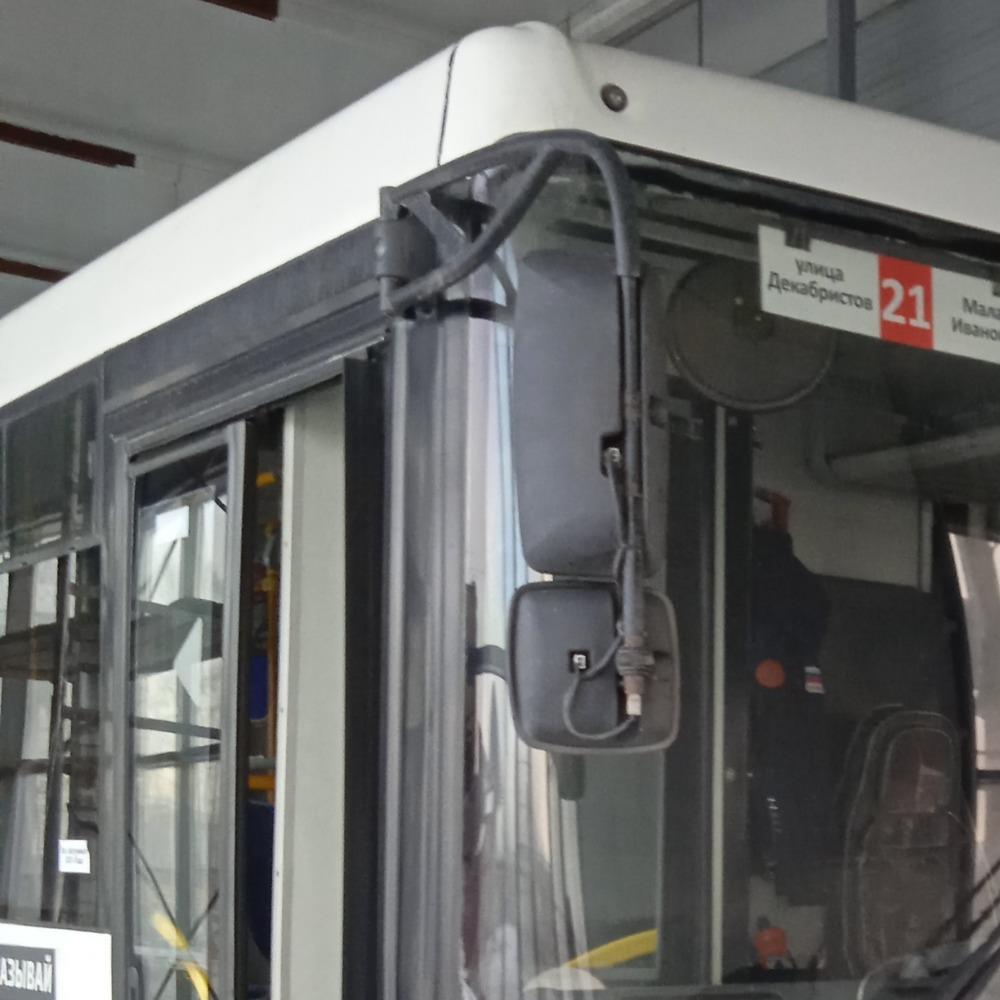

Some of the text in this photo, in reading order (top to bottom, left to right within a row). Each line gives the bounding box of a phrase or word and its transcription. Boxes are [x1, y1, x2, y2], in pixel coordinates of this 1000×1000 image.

[795, 257, 845, 282] улица
[767, 271, 873, 311] Декабристов
[881, 278, 931, 330] 21
